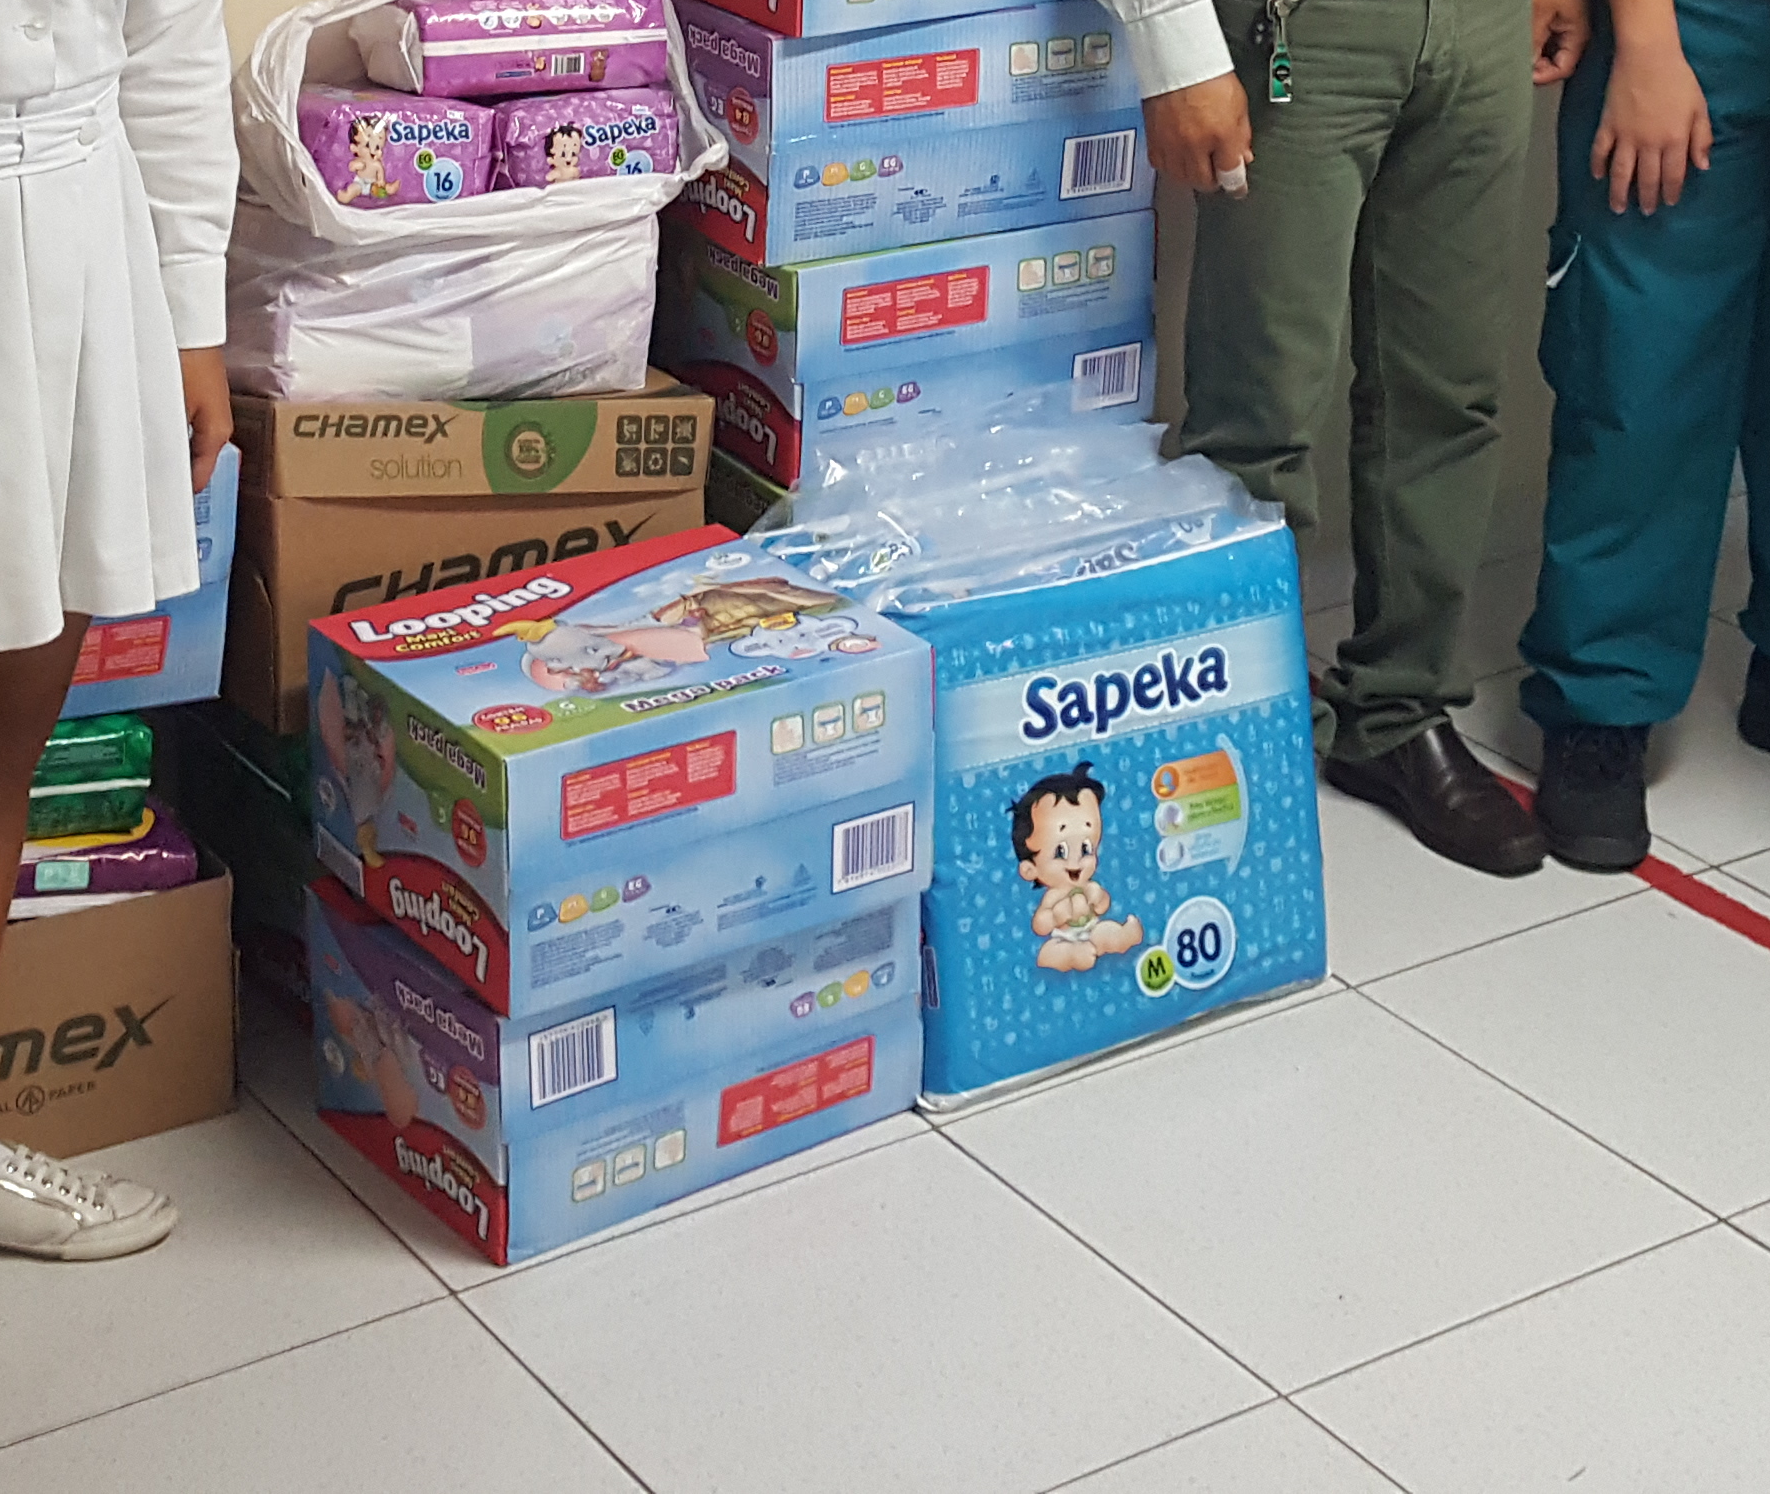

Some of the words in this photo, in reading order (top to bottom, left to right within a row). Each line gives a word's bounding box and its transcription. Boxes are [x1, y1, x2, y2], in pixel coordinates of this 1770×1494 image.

[687, 21, 720, 52] pack
[720, 41, 762, 79] Mega
[388, 119, 472, 146] Sapeka
[583, 114, 658, 148] Sapeka
[433, 171, 454, 193] 16
[682, 174, 758, 244] Loopin
[742, 263, 779, 301] Mega
[370, 454, 464, 480] solution
[350, 575, 574, 644] Looping
[405, 627, 457, 644] Maxi
[622, 684, 712, 714] Mega
[712, 664, 788, 692] pack
[1023, 645, 1229, 742] Sapeka
[407, 714, 445, 753] pack
[444, 741, 487, 792] Mega
[389, 875, 489, 984] Looping
[1176, 922, 1222, 968] 80
[1147, 956, 1167, 979] M
[393, 1135, 490, 1242] Looping
